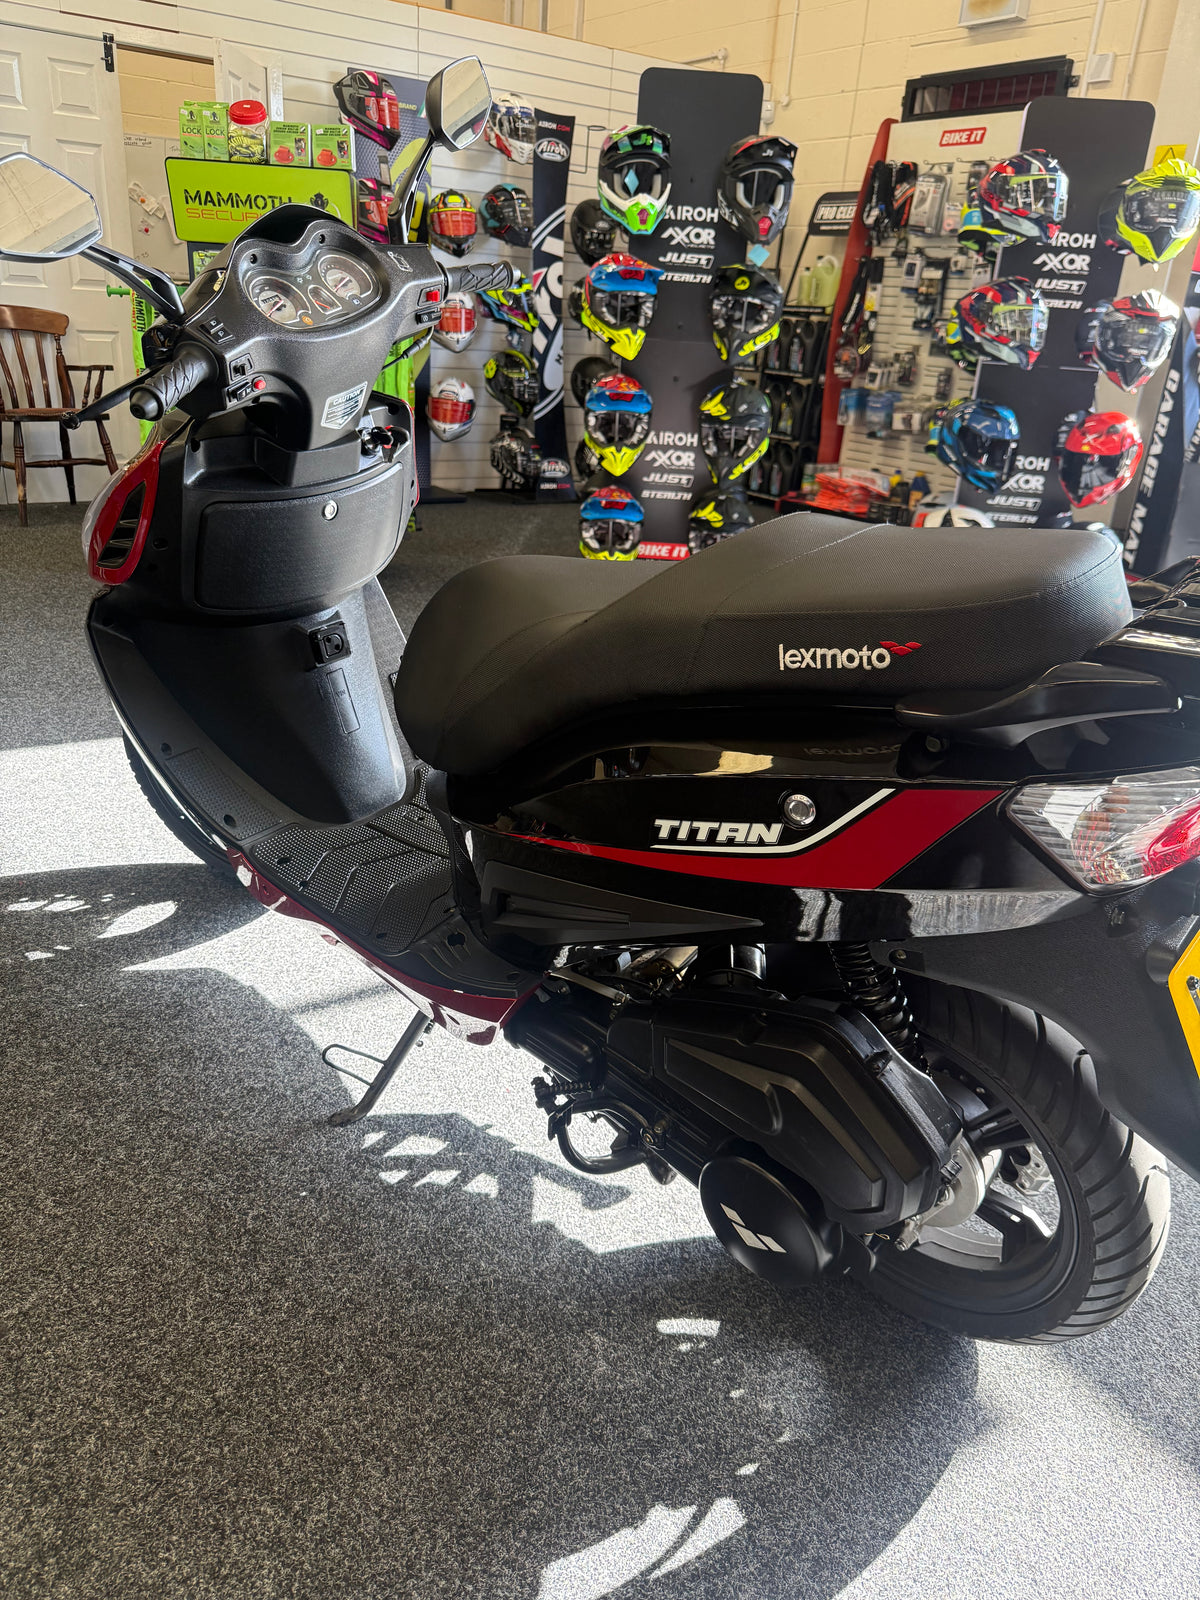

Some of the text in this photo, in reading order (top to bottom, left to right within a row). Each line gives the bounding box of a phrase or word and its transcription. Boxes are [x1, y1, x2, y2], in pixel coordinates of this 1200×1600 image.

[182, 126, 202, 135] LOCK
[205, 127, 225, 136] LOCK
[941, 130, 985, 145] BIKE IT
[184, 189, 293, 211] MAMMOTH
[186, 208, 263, 222] SECUR
[664, 204, 719, 223] AIROH
[660, 225, 716, 247] AXOR
[1032, 251, 1091, 272] AXOR
[644, 430, 699, 448] AIROH
[643, 448, 696, 467] AXOR
[1014, 454, 1051, 472] ROH
[1124, 369, 1181, 569] GARAGE MAT
[641, 489, 693, 501] STEALTH
[639, 543, 688, 558] BIKE IT
[778, 643, 891, 671] lexmoto
[654, 818, 785, 844] TITAN
